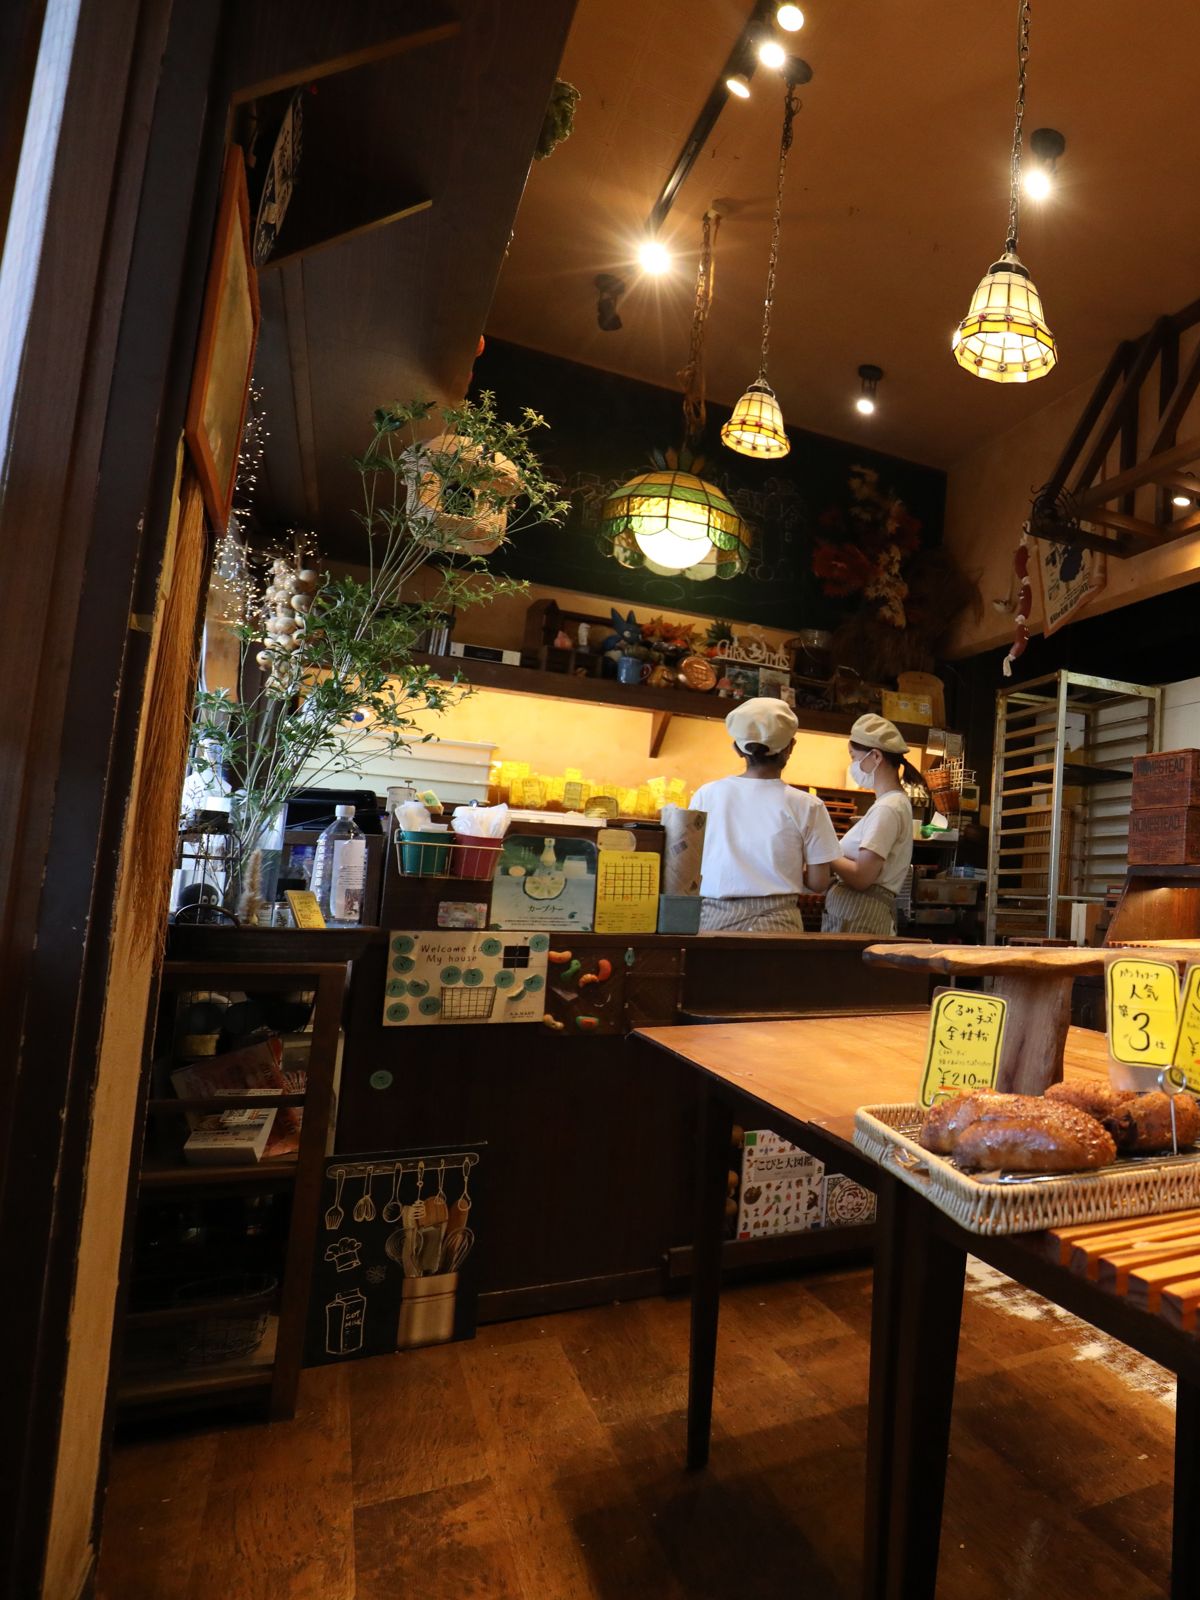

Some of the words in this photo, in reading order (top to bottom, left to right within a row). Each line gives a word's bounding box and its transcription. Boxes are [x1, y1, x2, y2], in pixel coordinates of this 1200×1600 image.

[420, 943, 467, 953] Welcome
[426, 954, 442, 966] My
[448, 953, 478, 963] house
[1129, 983, 1159, 1002] 人気
[937, 1067, 977, 1088] ¥210
[755, 1155, 814, 1172] こびと大図鑑
